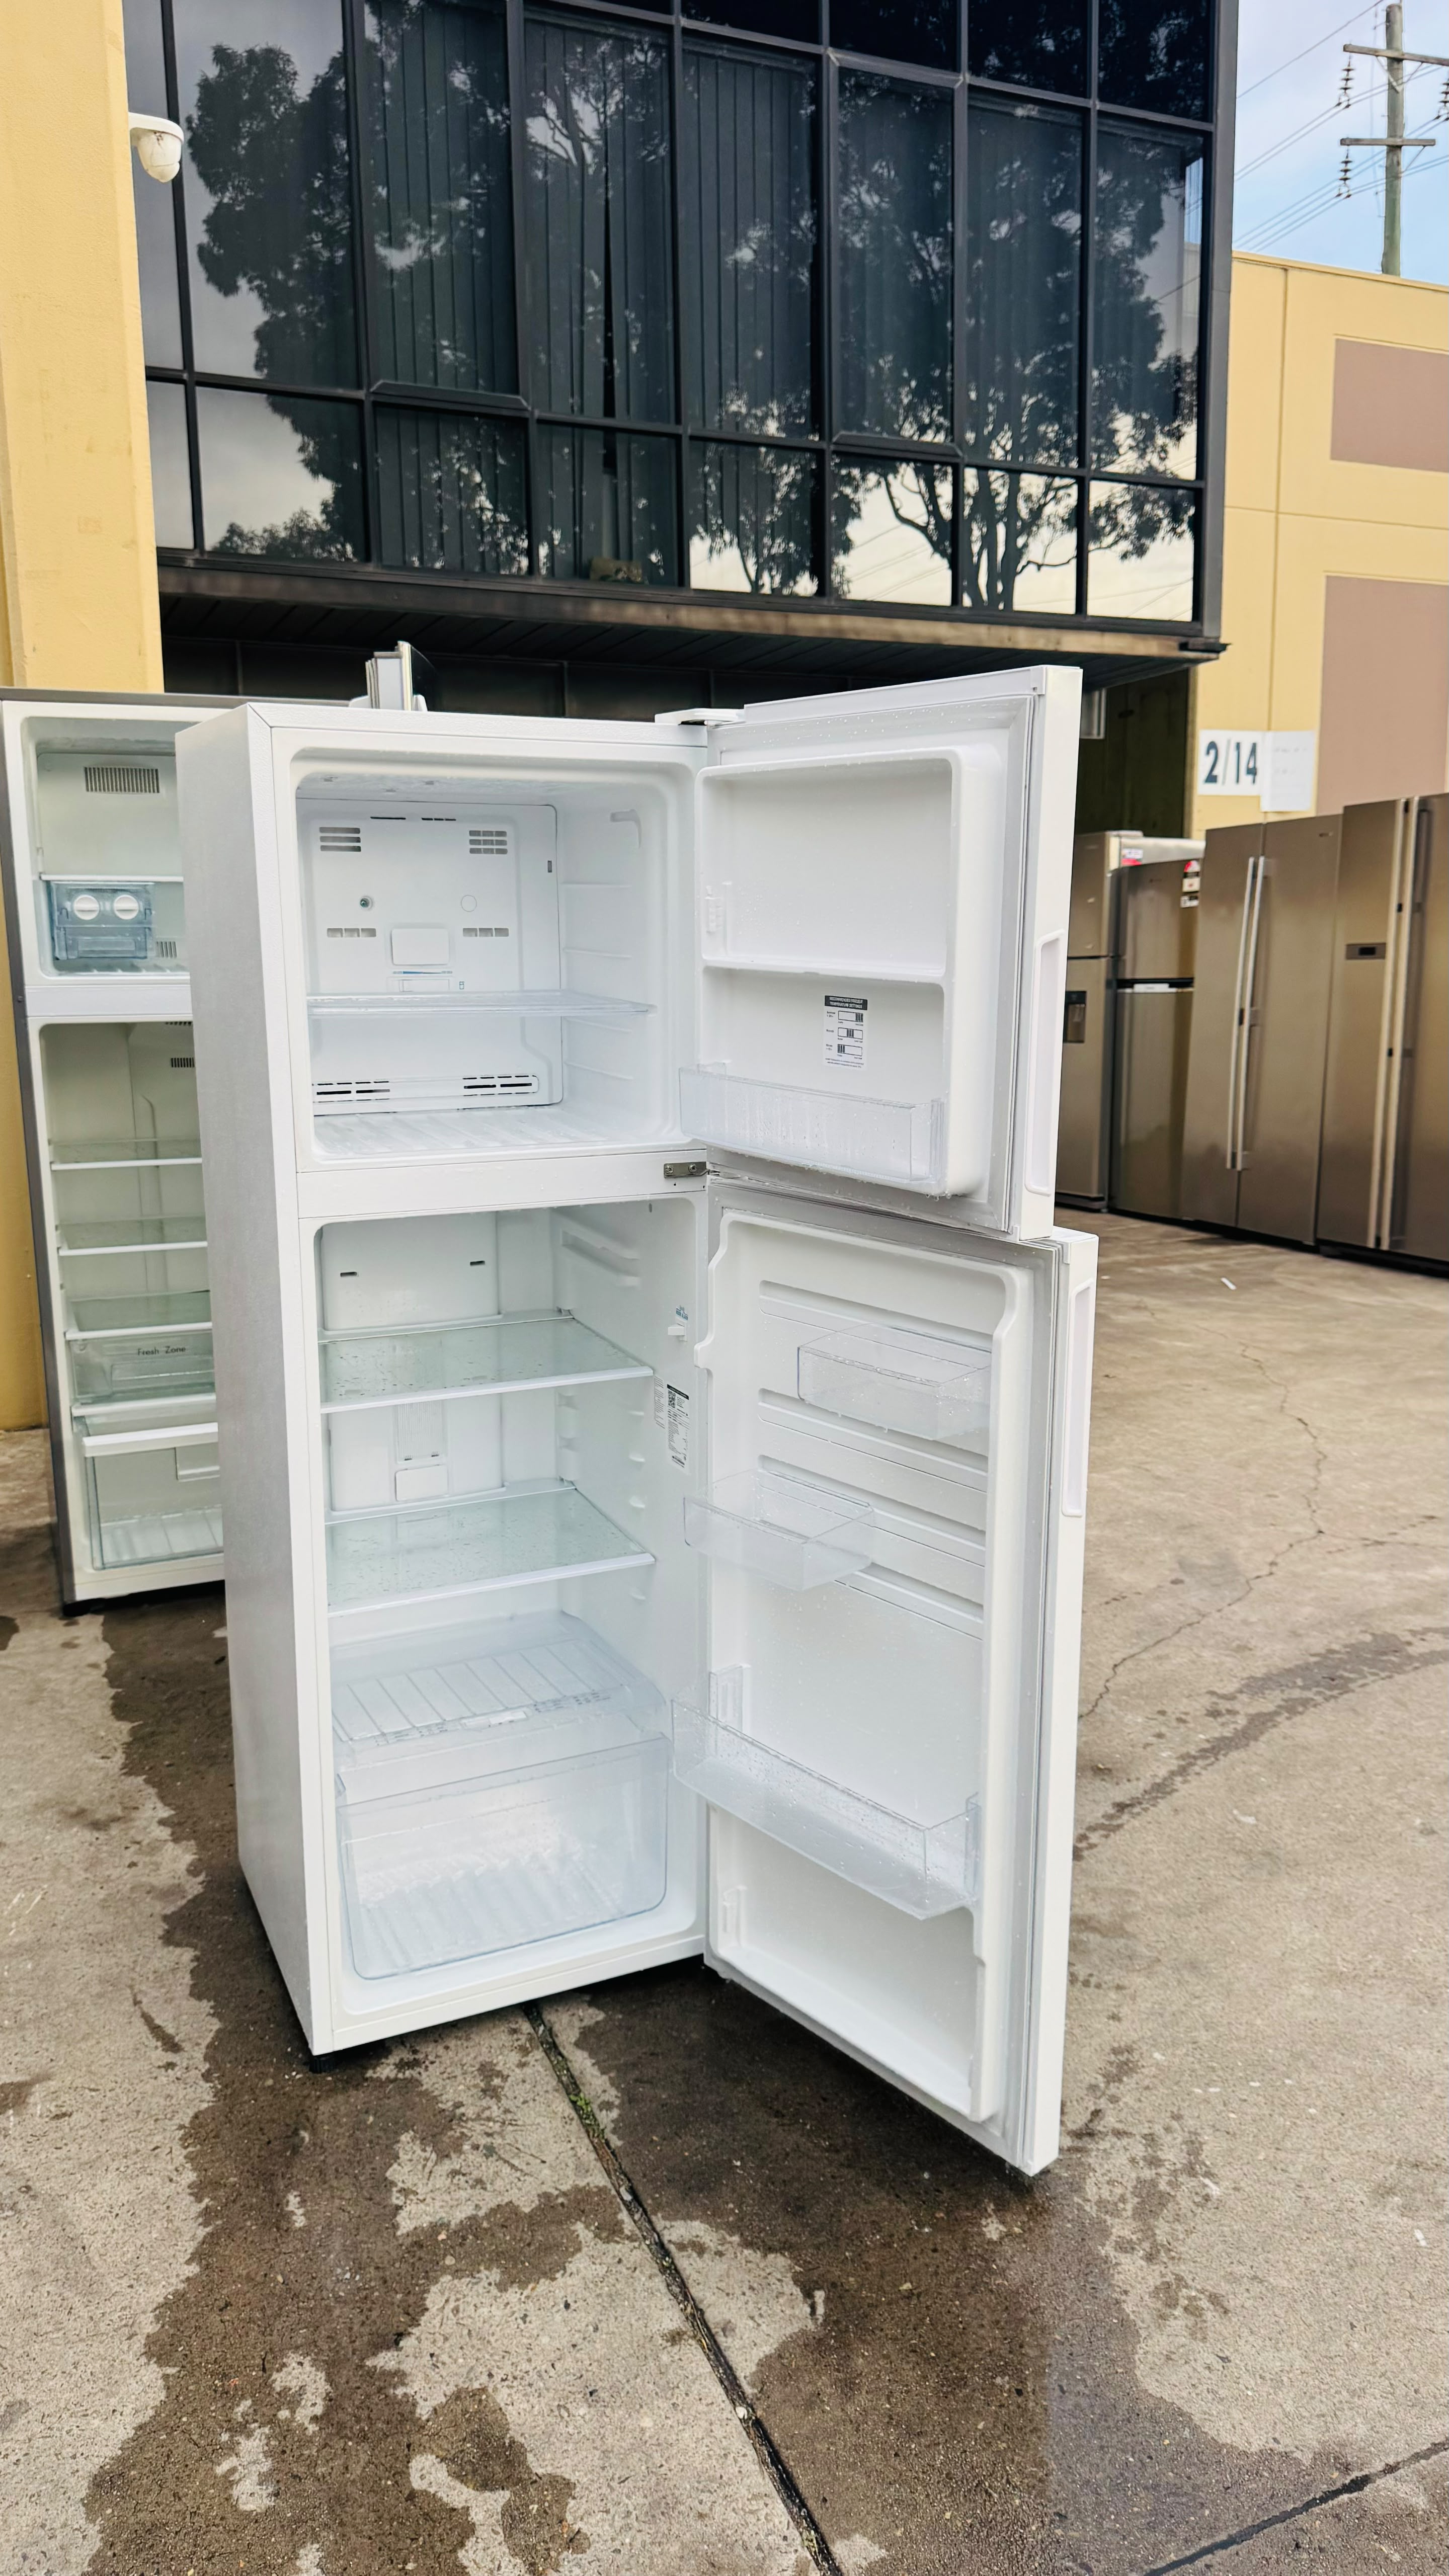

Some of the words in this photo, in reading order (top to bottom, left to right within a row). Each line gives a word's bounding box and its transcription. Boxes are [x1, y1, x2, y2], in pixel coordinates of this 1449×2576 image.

[1204, 739, 1257, 785] 2/14
[137, 1346, 159, 1355] Fresh
[165, 1345, 186, 1354] Zone
